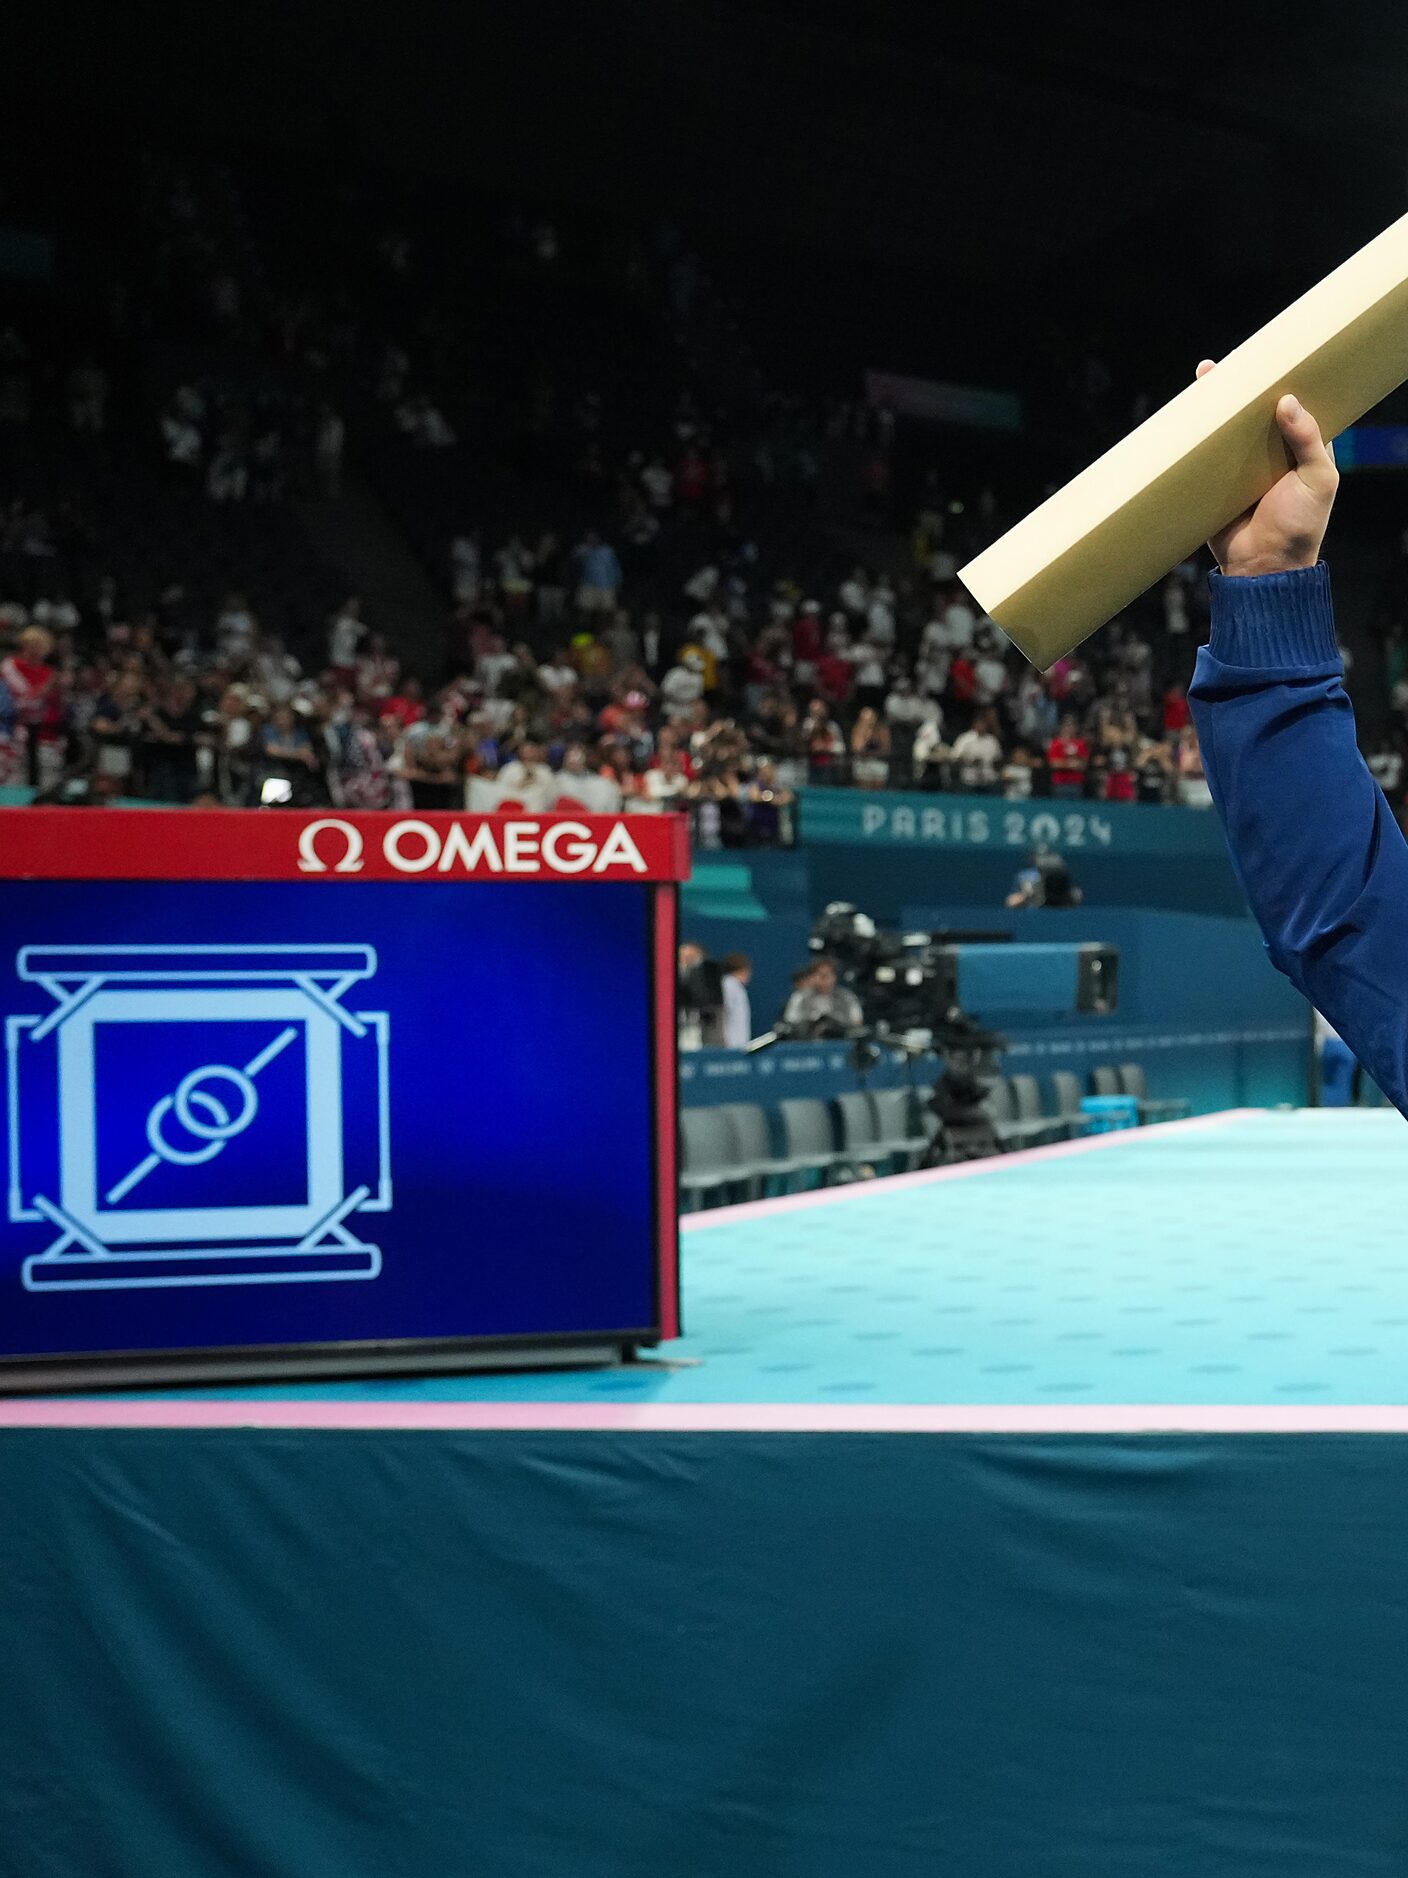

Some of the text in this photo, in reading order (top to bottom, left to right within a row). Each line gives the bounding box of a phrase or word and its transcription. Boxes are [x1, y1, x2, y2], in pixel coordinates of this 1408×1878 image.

[382, 819, 648, 874] OMEGA
[862, 804, 1112, 847] PARIS 2024
